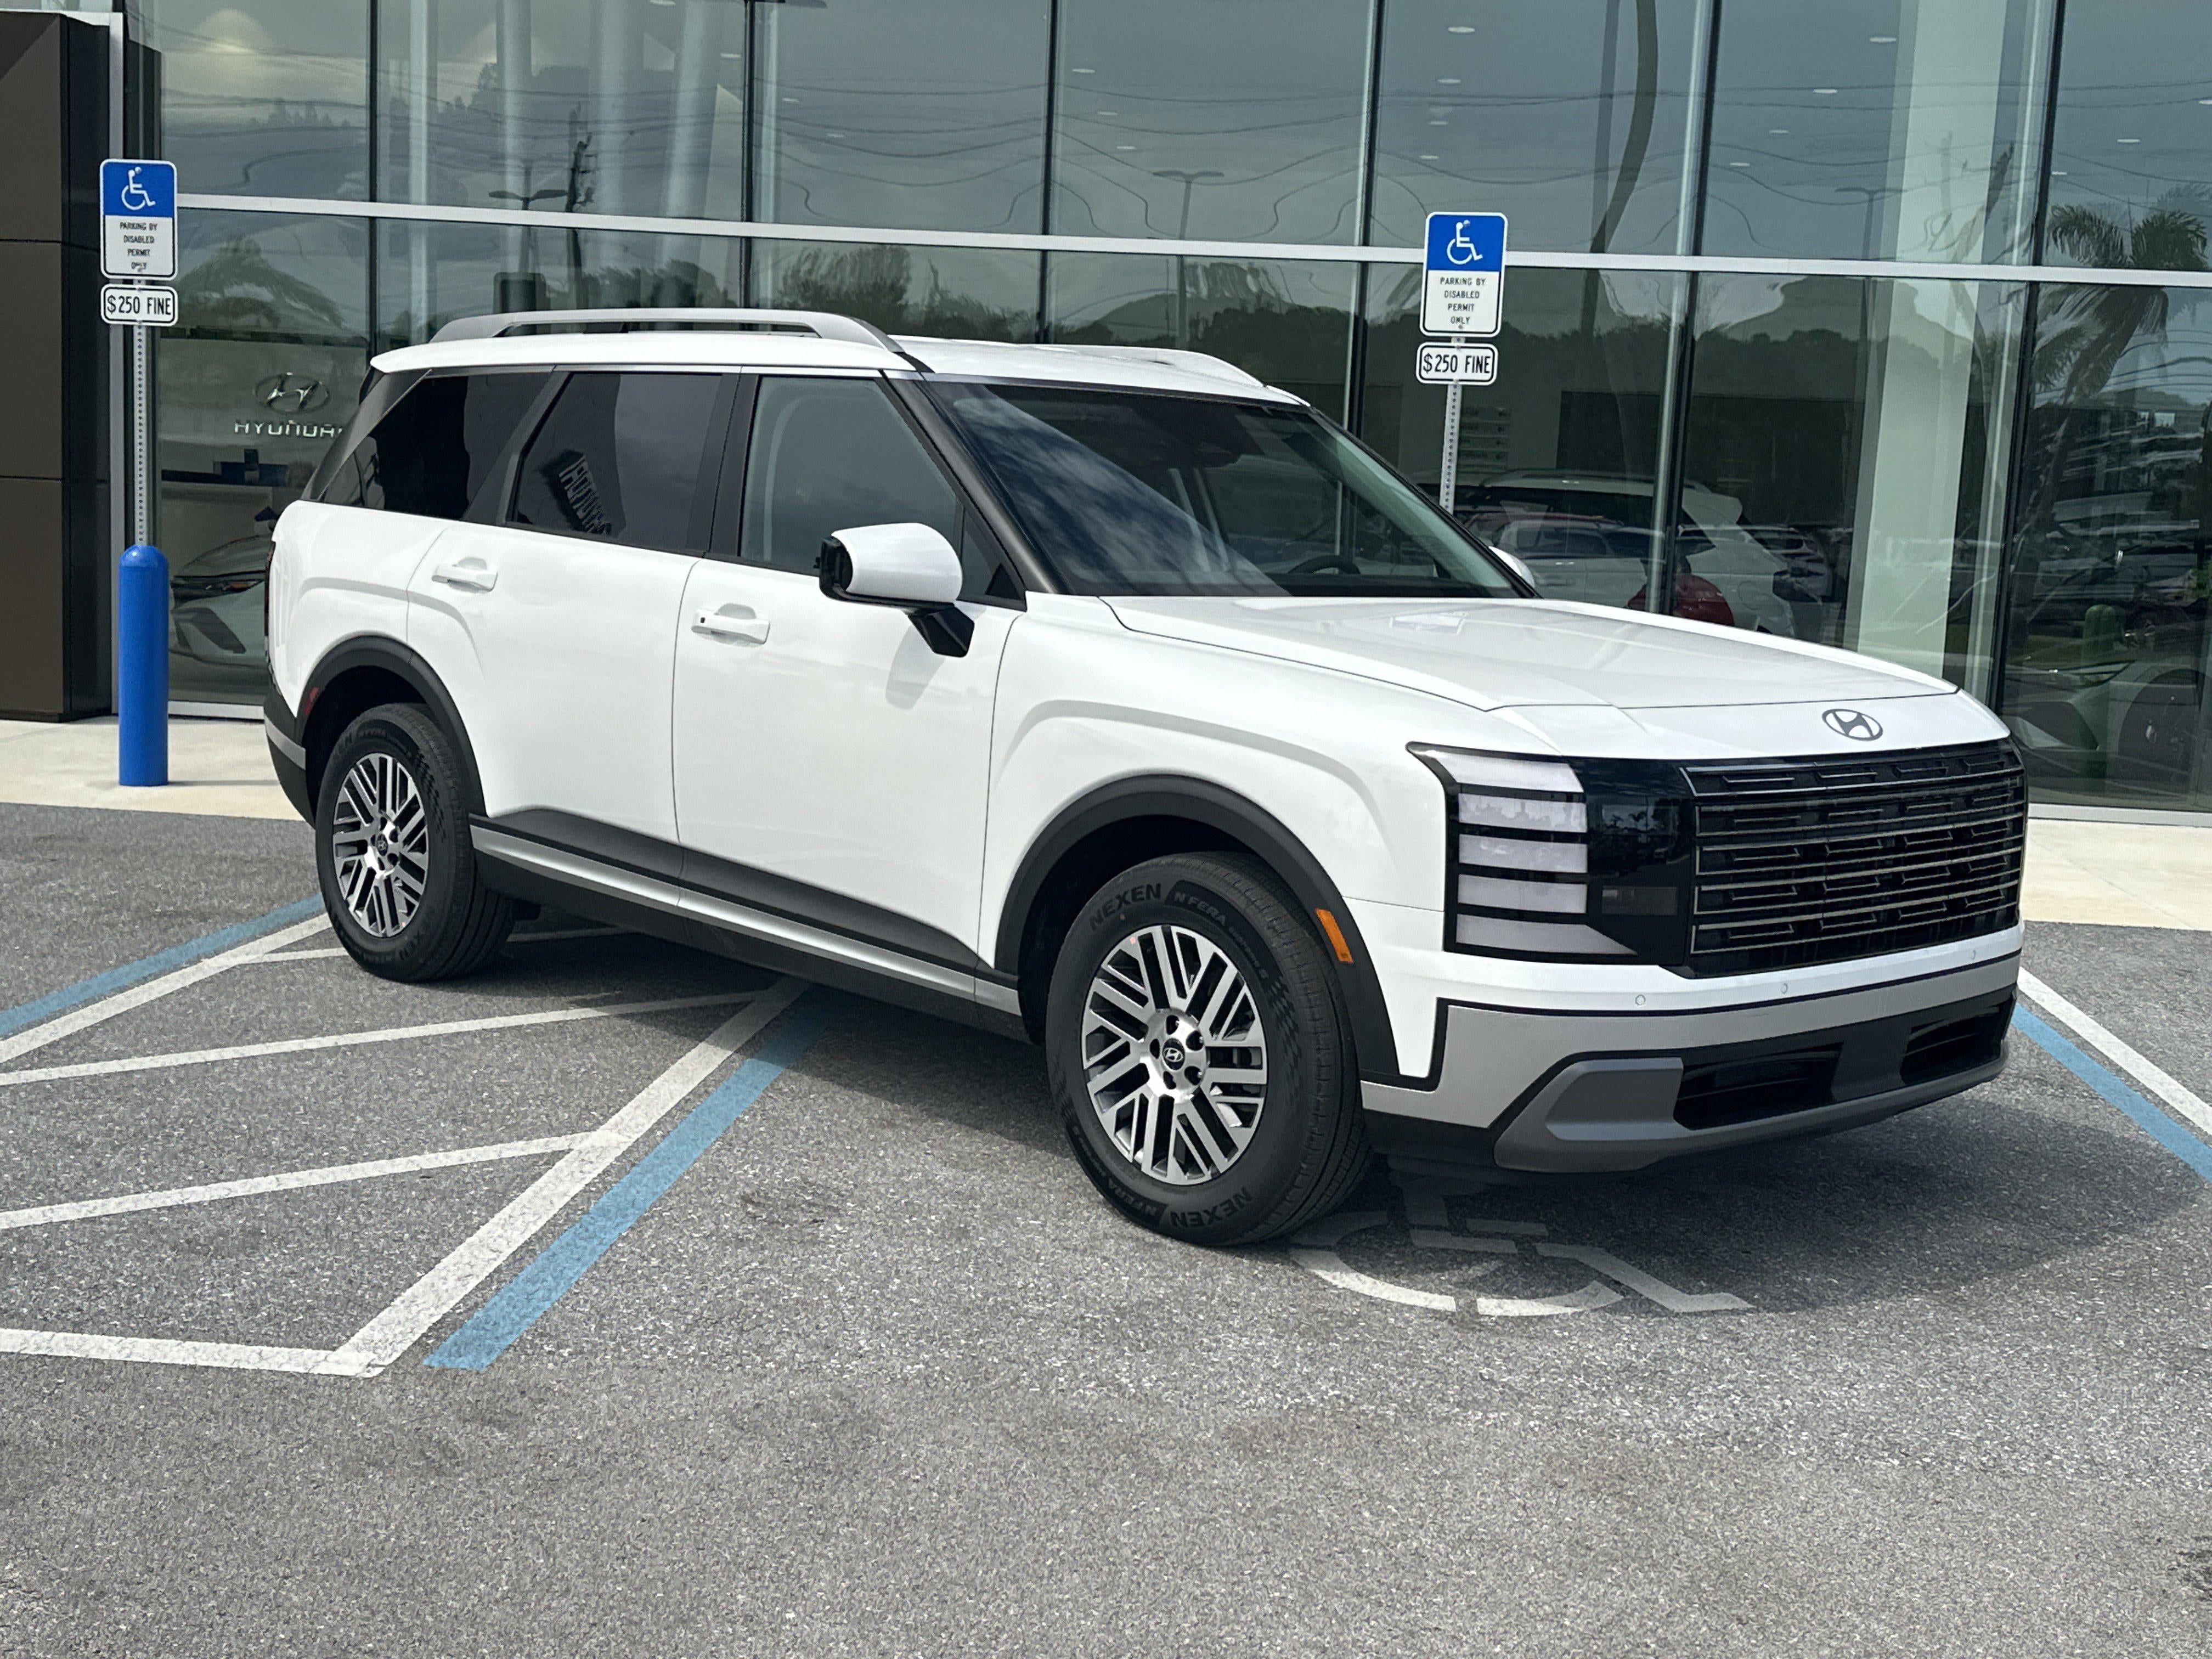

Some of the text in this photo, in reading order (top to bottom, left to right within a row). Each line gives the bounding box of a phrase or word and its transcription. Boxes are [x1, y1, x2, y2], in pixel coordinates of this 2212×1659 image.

[120, 222, 146, 230] PARKING
[123, 235, 154, 243] DISABLED
[127, 248, 150, 256] PERMIT
[1440, 276, 1486, 286] PARKING BY
[1444, 290, 1480, 299] DISABLED
[107, 294, 171, 315] $250 FINE
[1448, 303, 1475, 312] PERMIT
[1451, 316, 1470, 325] ONLY
[1423, 352, 1491, 374] $250 FINE
[1089, 882, 1162, 931] NEXEN
[1169, 1186, 1253, 1229] NEXEN
